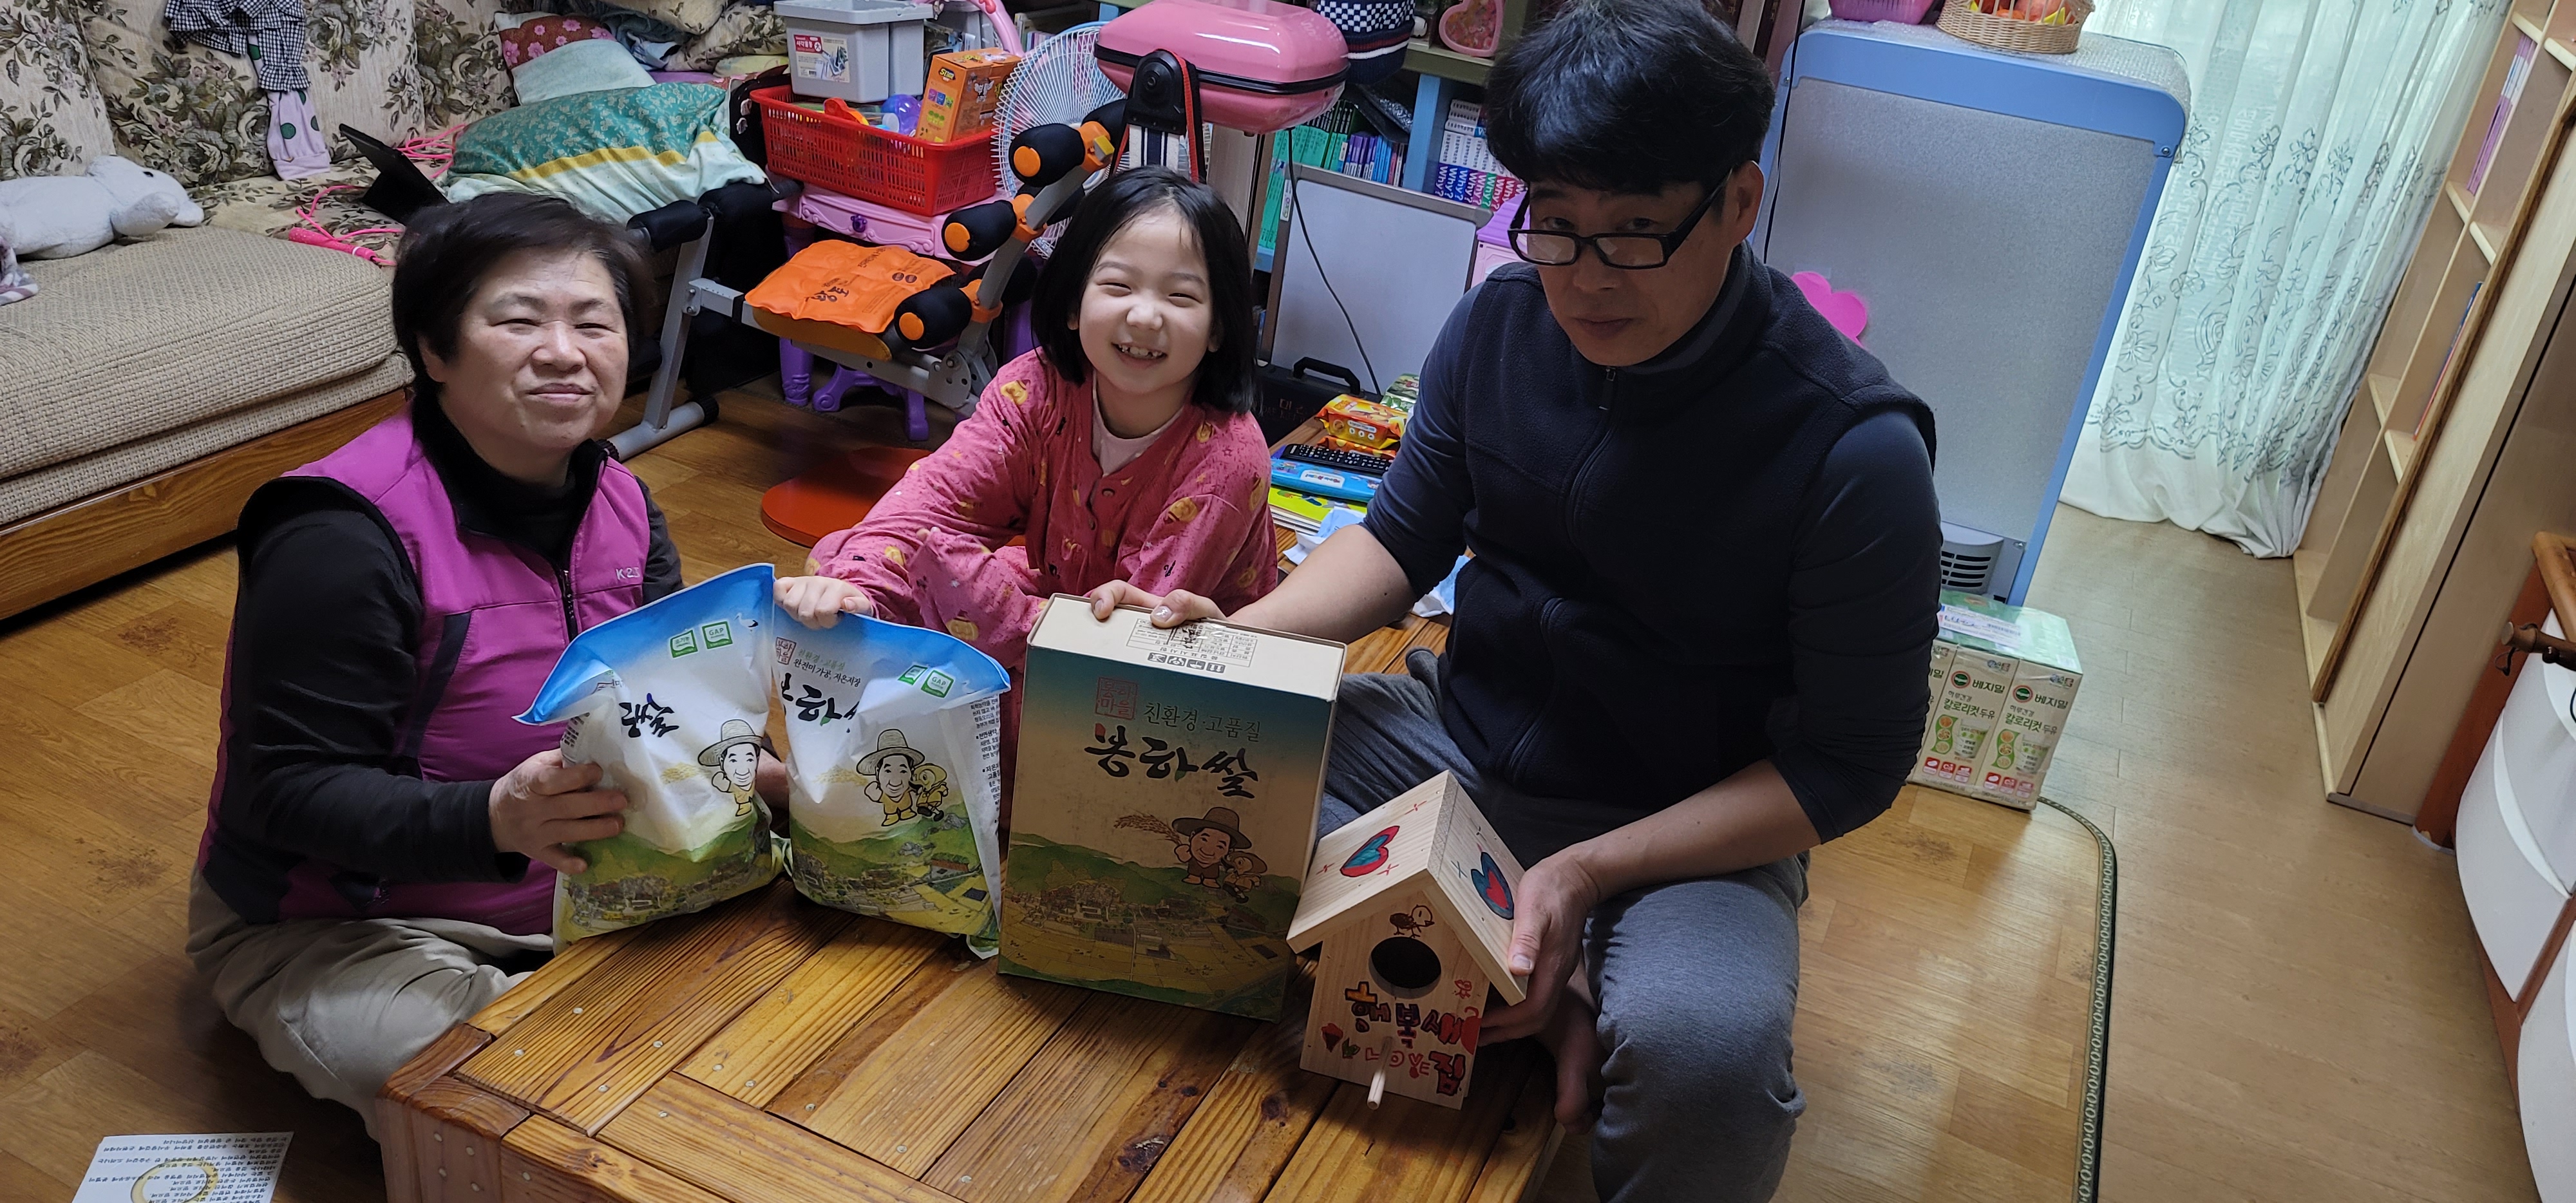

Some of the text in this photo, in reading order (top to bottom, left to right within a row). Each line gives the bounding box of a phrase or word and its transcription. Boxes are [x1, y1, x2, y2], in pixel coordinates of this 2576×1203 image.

[1435, 166, 1448, 197] Why?
[1444, 167, 1458, 199] Why?
[1455, 169, 1468, 201] Why?
[1464, 172, 1478, 204] Why?
[1472, 175, 1487, 205] Why?
[1482, 176, 1496, 207] Why?
[1492, 178, 1505, 210] Why?
[1502, 180, 1515, 202] Why
[708, 627, 724, 636] GAP
[793, 658, 816, 674] 완전미
[834, 673, 861, 688] 저온저장
[932, 676, 946, 686] GAP
[1972, 679, 2005, 694] 베지밀
[1943, 697, 1995, 720] 칼로리컷 두유
[2034, 693, 2069, 710] 베지밀
[2005, 712, 2058, 735] 칼로리컷 두유
[1084, 723, 1258, 799] 봉하쌀
